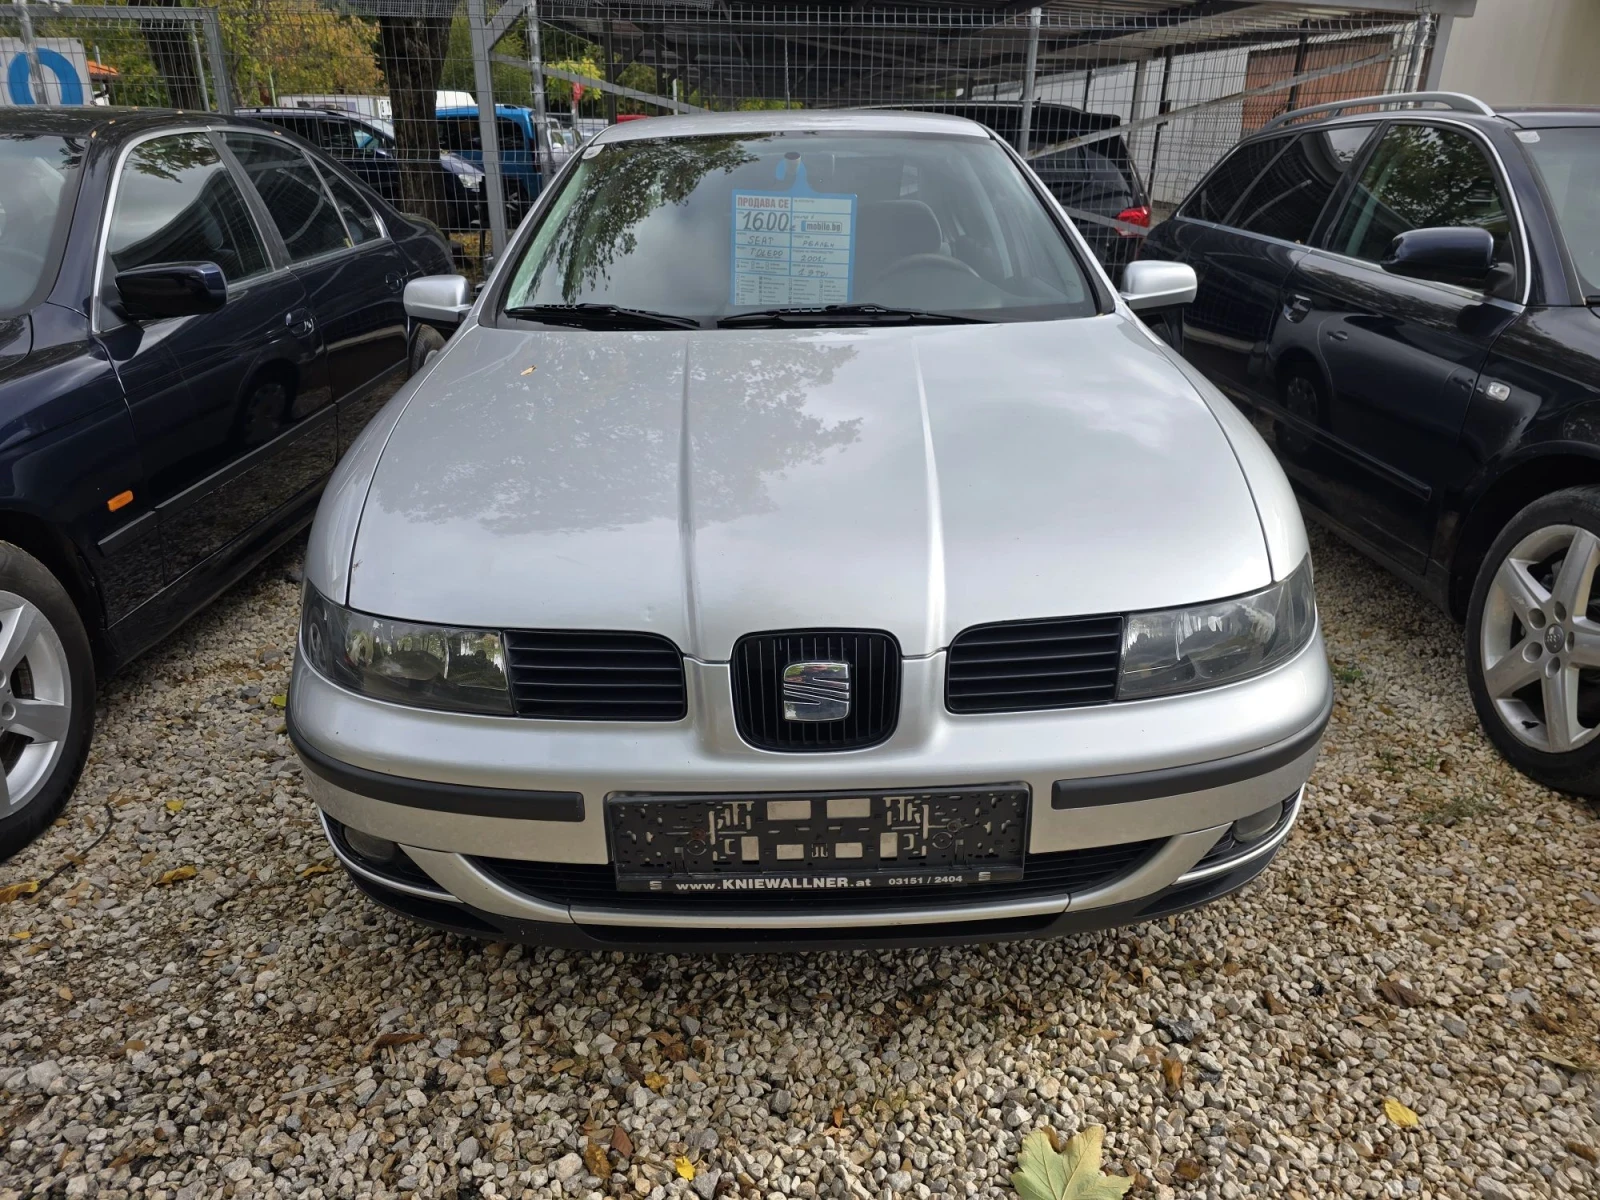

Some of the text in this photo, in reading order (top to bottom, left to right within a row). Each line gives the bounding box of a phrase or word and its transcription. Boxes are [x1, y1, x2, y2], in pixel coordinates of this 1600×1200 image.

[737, 196, 776, 209] ПРОДАВА
[778, 198, 789, 209] СЕ
[742, 210, 790, 231] 1600
[806, 221, 841, 232] mobile.bg
[747, 235, 774, 245] SEAT
[750, 247, 784, 258] TOLEDO
[676, 877, 872, 890] www.KNIEWALLNER.at
[934, 875, 963, 884] 2404
